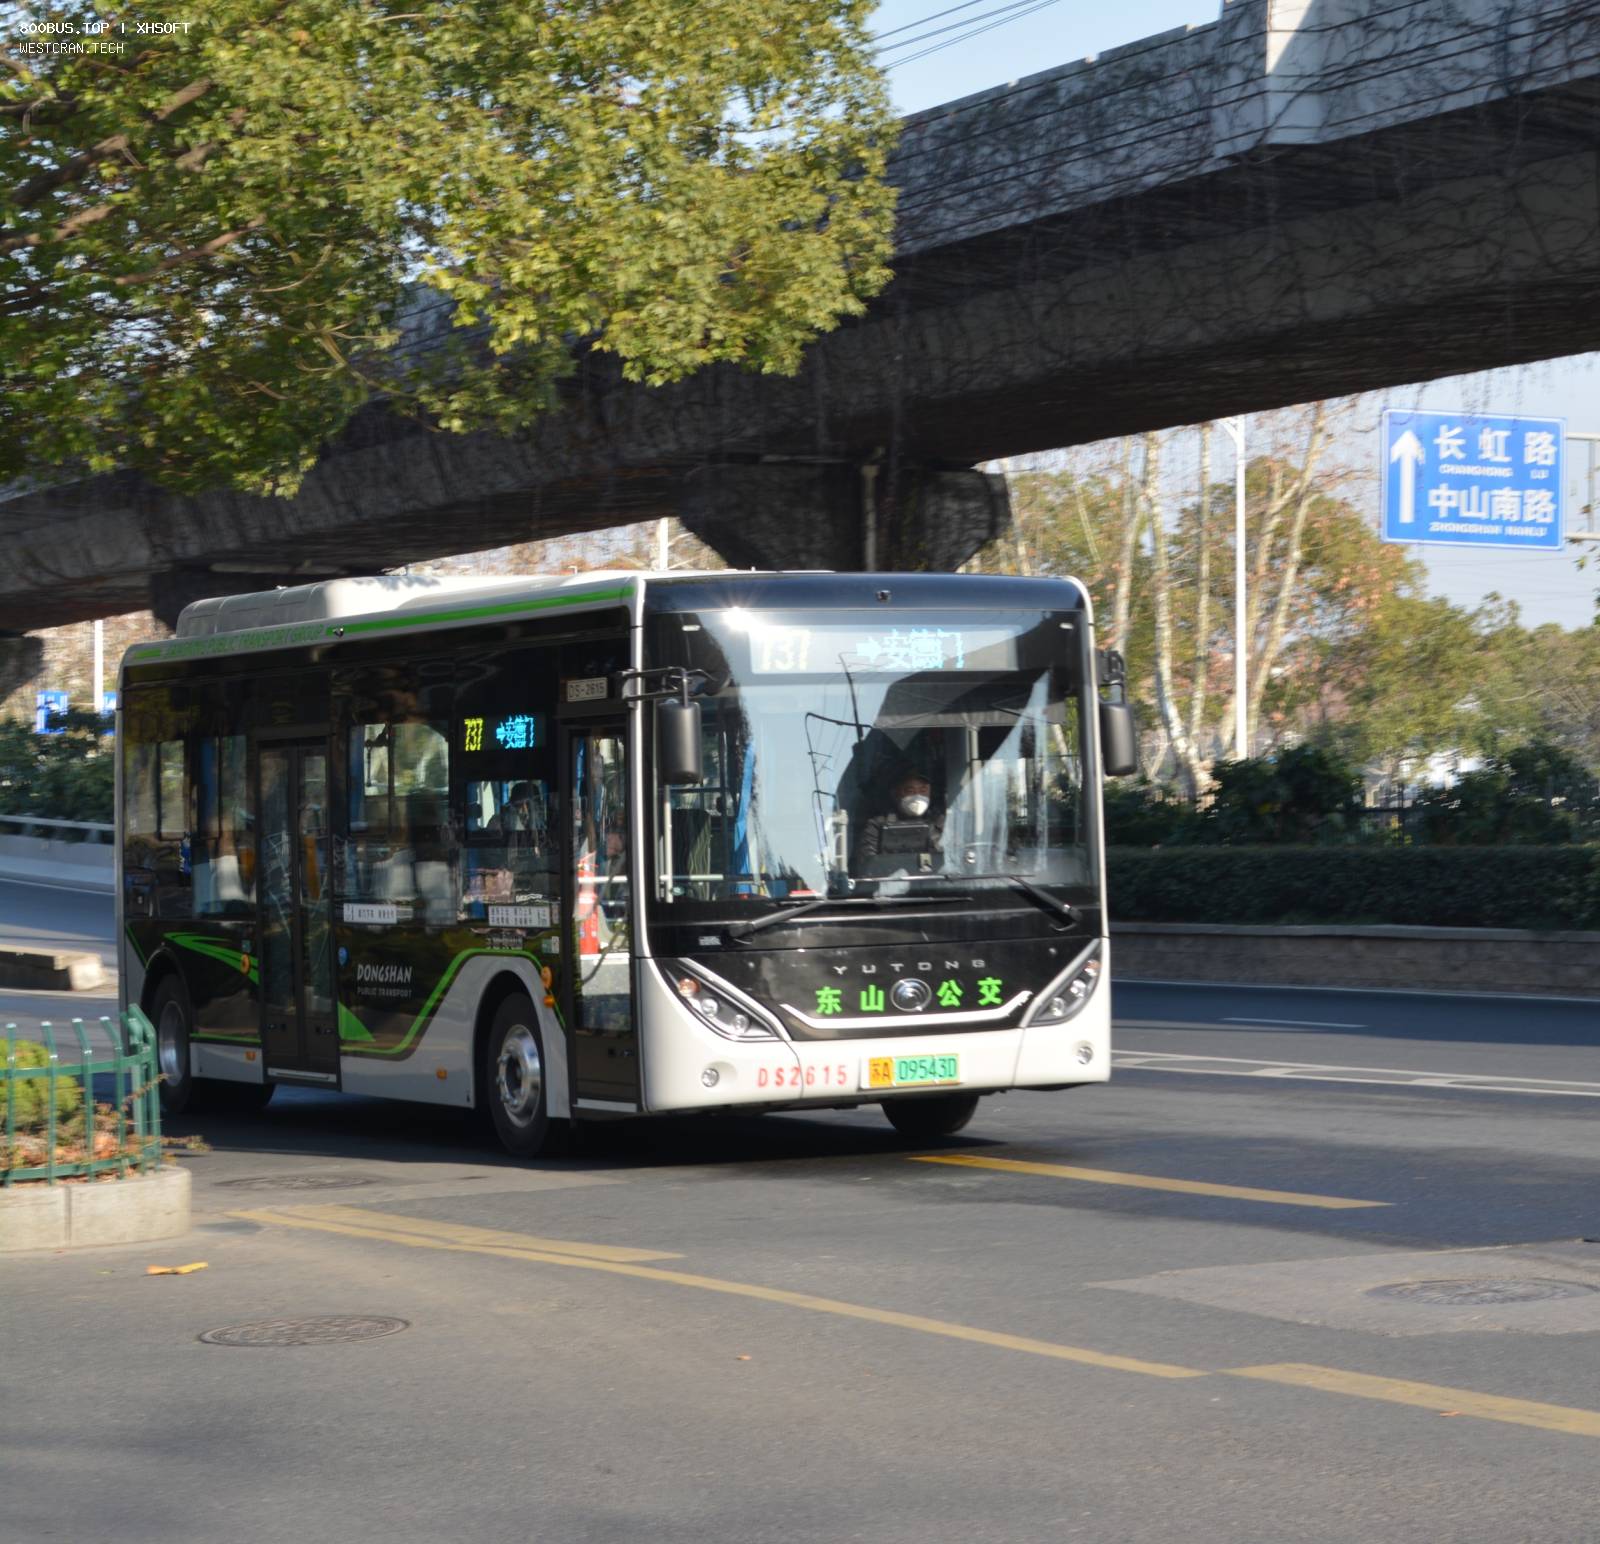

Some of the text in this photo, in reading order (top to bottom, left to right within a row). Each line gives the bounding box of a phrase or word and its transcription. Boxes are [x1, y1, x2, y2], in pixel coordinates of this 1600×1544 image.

[1433, 425, 1557, 465] 长虹路
[1428, 483, 1557, 523] 中山南路
[357, 964, 412, 984] DONGSHAN
[832, 959, 985, 976] YUTONG
[757, 1064, 848, 1089] DS2615
